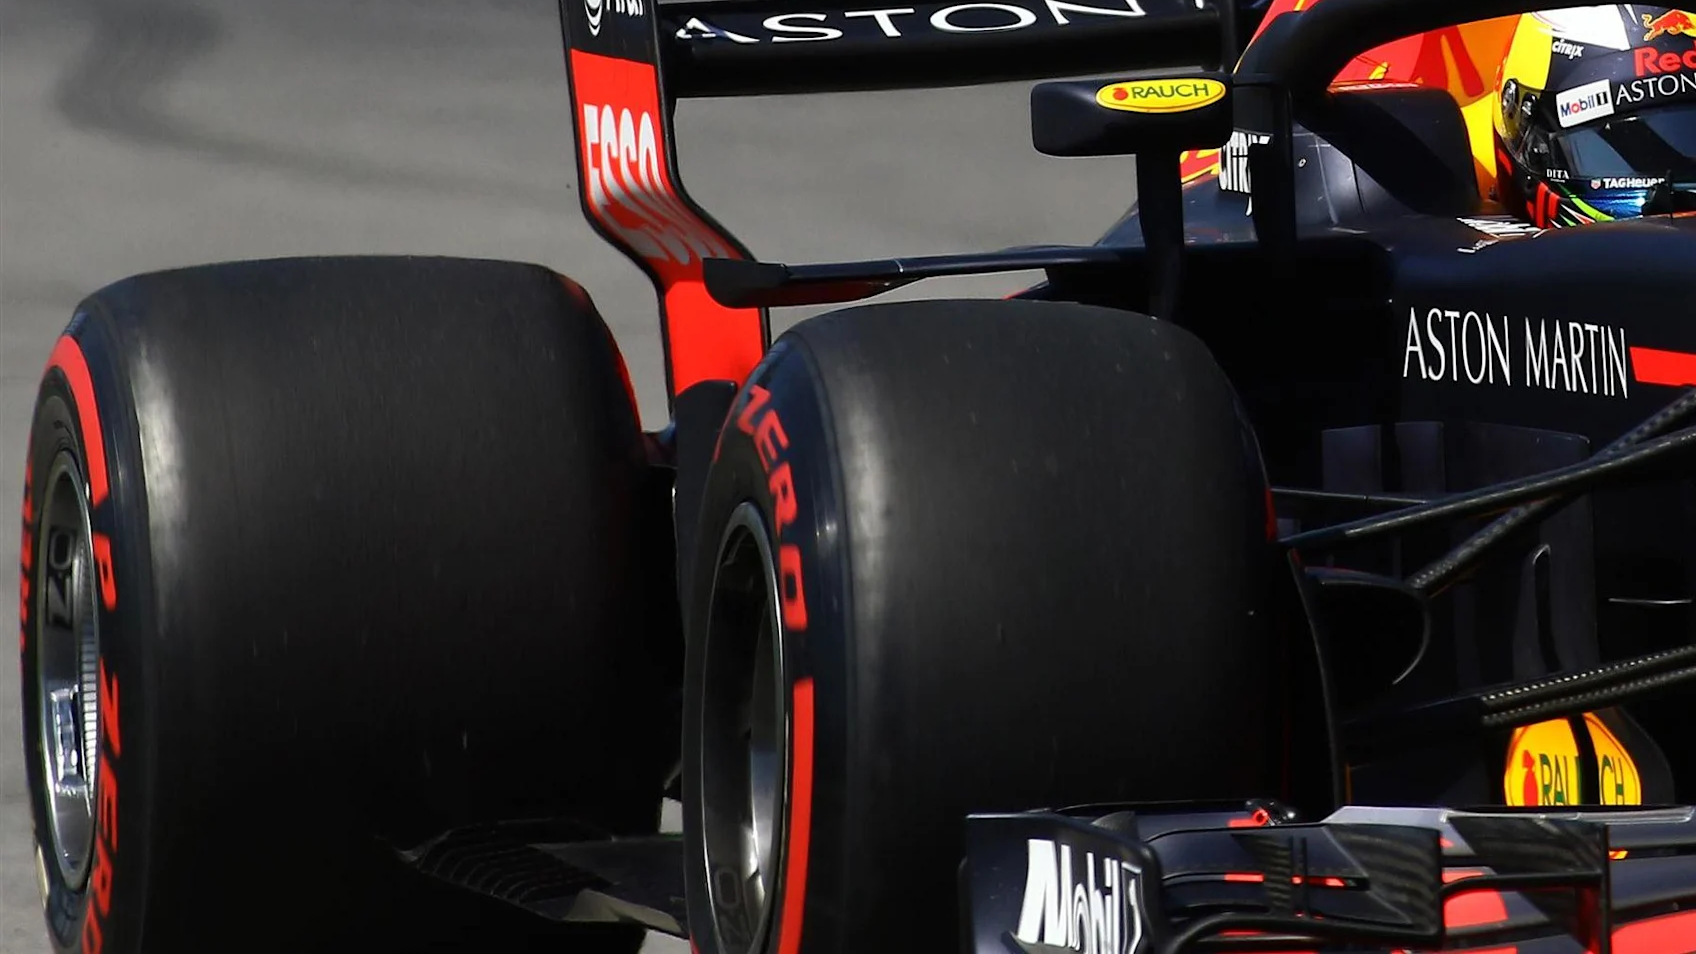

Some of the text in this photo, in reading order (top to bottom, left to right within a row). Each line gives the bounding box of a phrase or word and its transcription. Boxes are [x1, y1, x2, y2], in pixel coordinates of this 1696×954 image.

[1131, 83, 1210, 99] RAUCH
[1560, 94, 1595, 118] Mobil
[1403, 307, 1628, 399] ASTON MARTIN
[736, 384, 808, 631] ZERO
